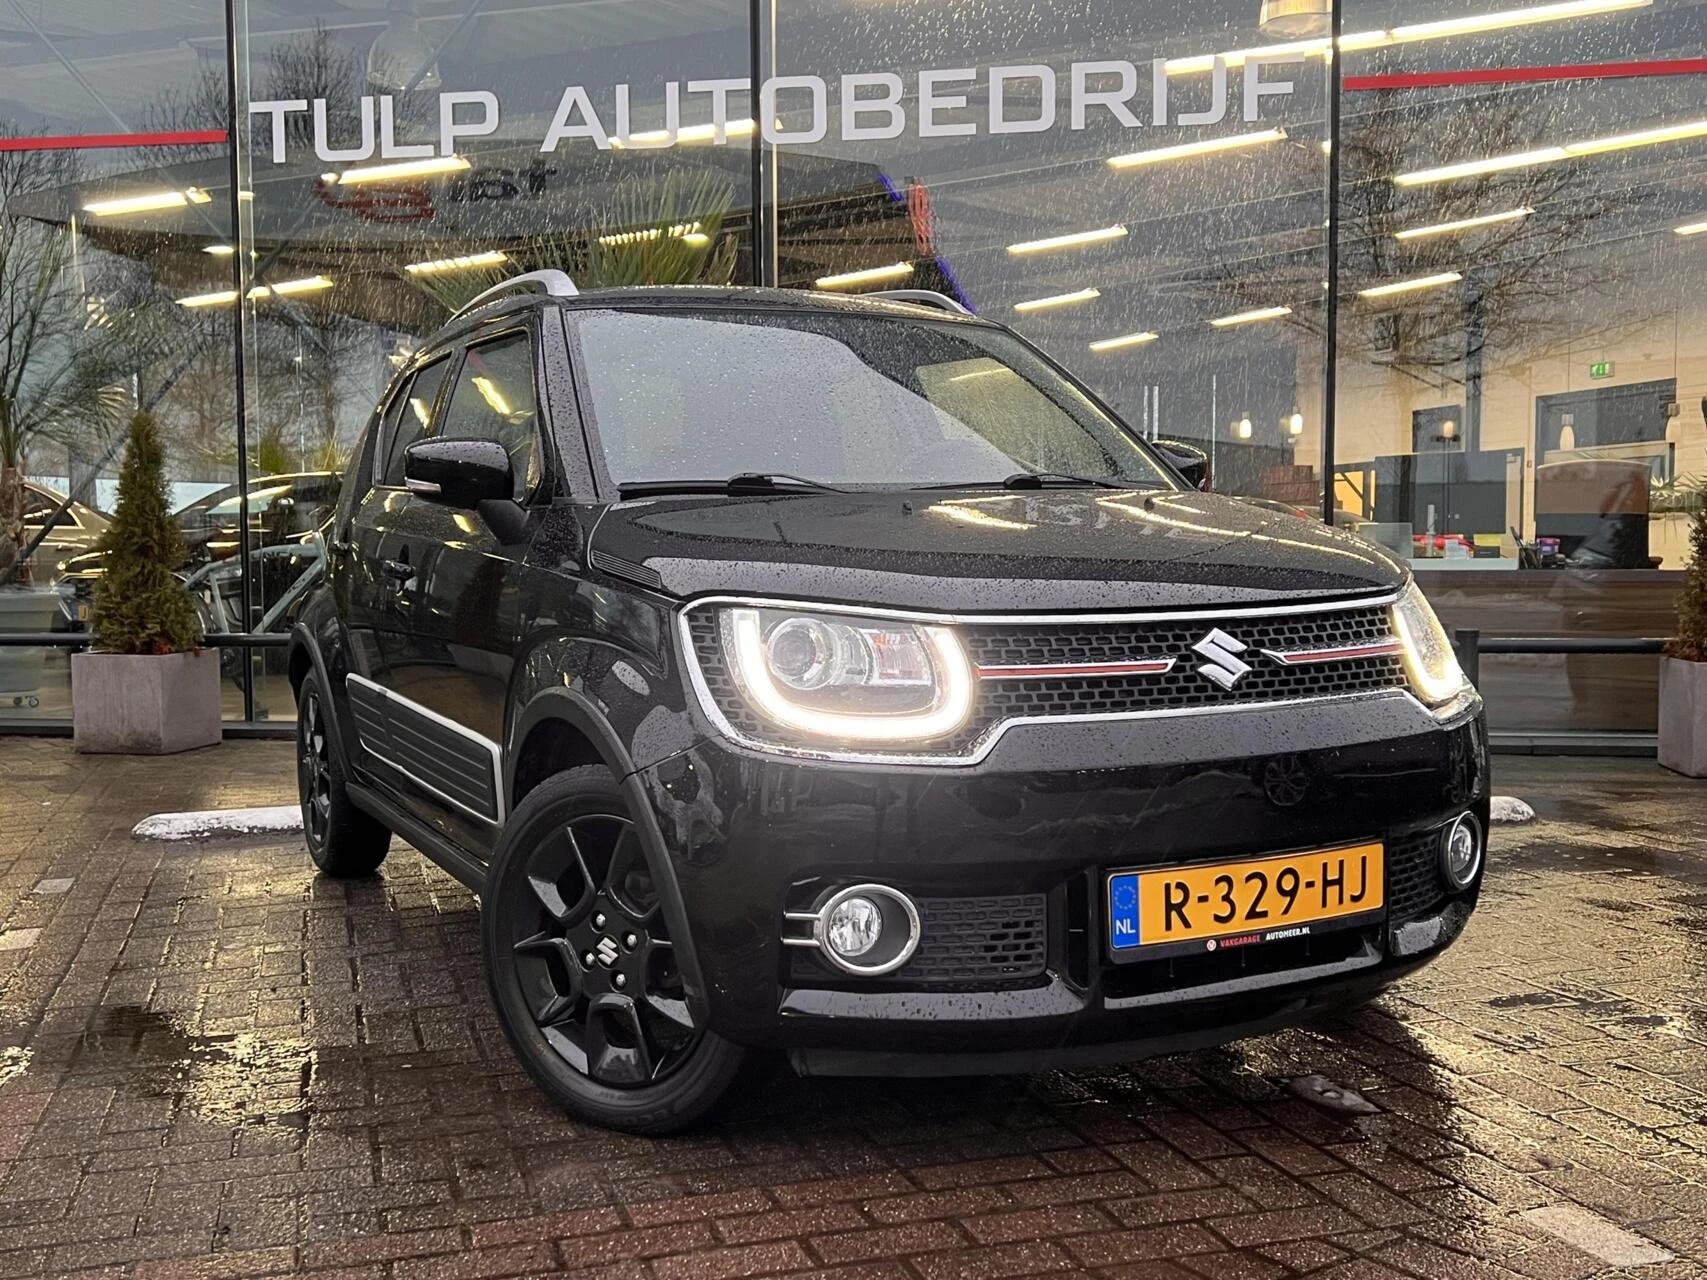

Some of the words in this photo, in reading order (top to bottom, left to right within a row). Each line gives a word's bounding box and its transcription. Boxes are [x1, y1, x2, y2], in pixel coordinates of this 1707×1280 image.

[249, 91, 500, 164] TULP
[540, 52, 1306, 153] AUTOBEDRIJF
[1164, 855, 1368, 932] R-329-HJ
[1115, 918, 1136, 935] NL
[1219, 934, 1261, 948] VAKGARAGE
[1265, 926, 1311, 941] AUTOMEER.NL
